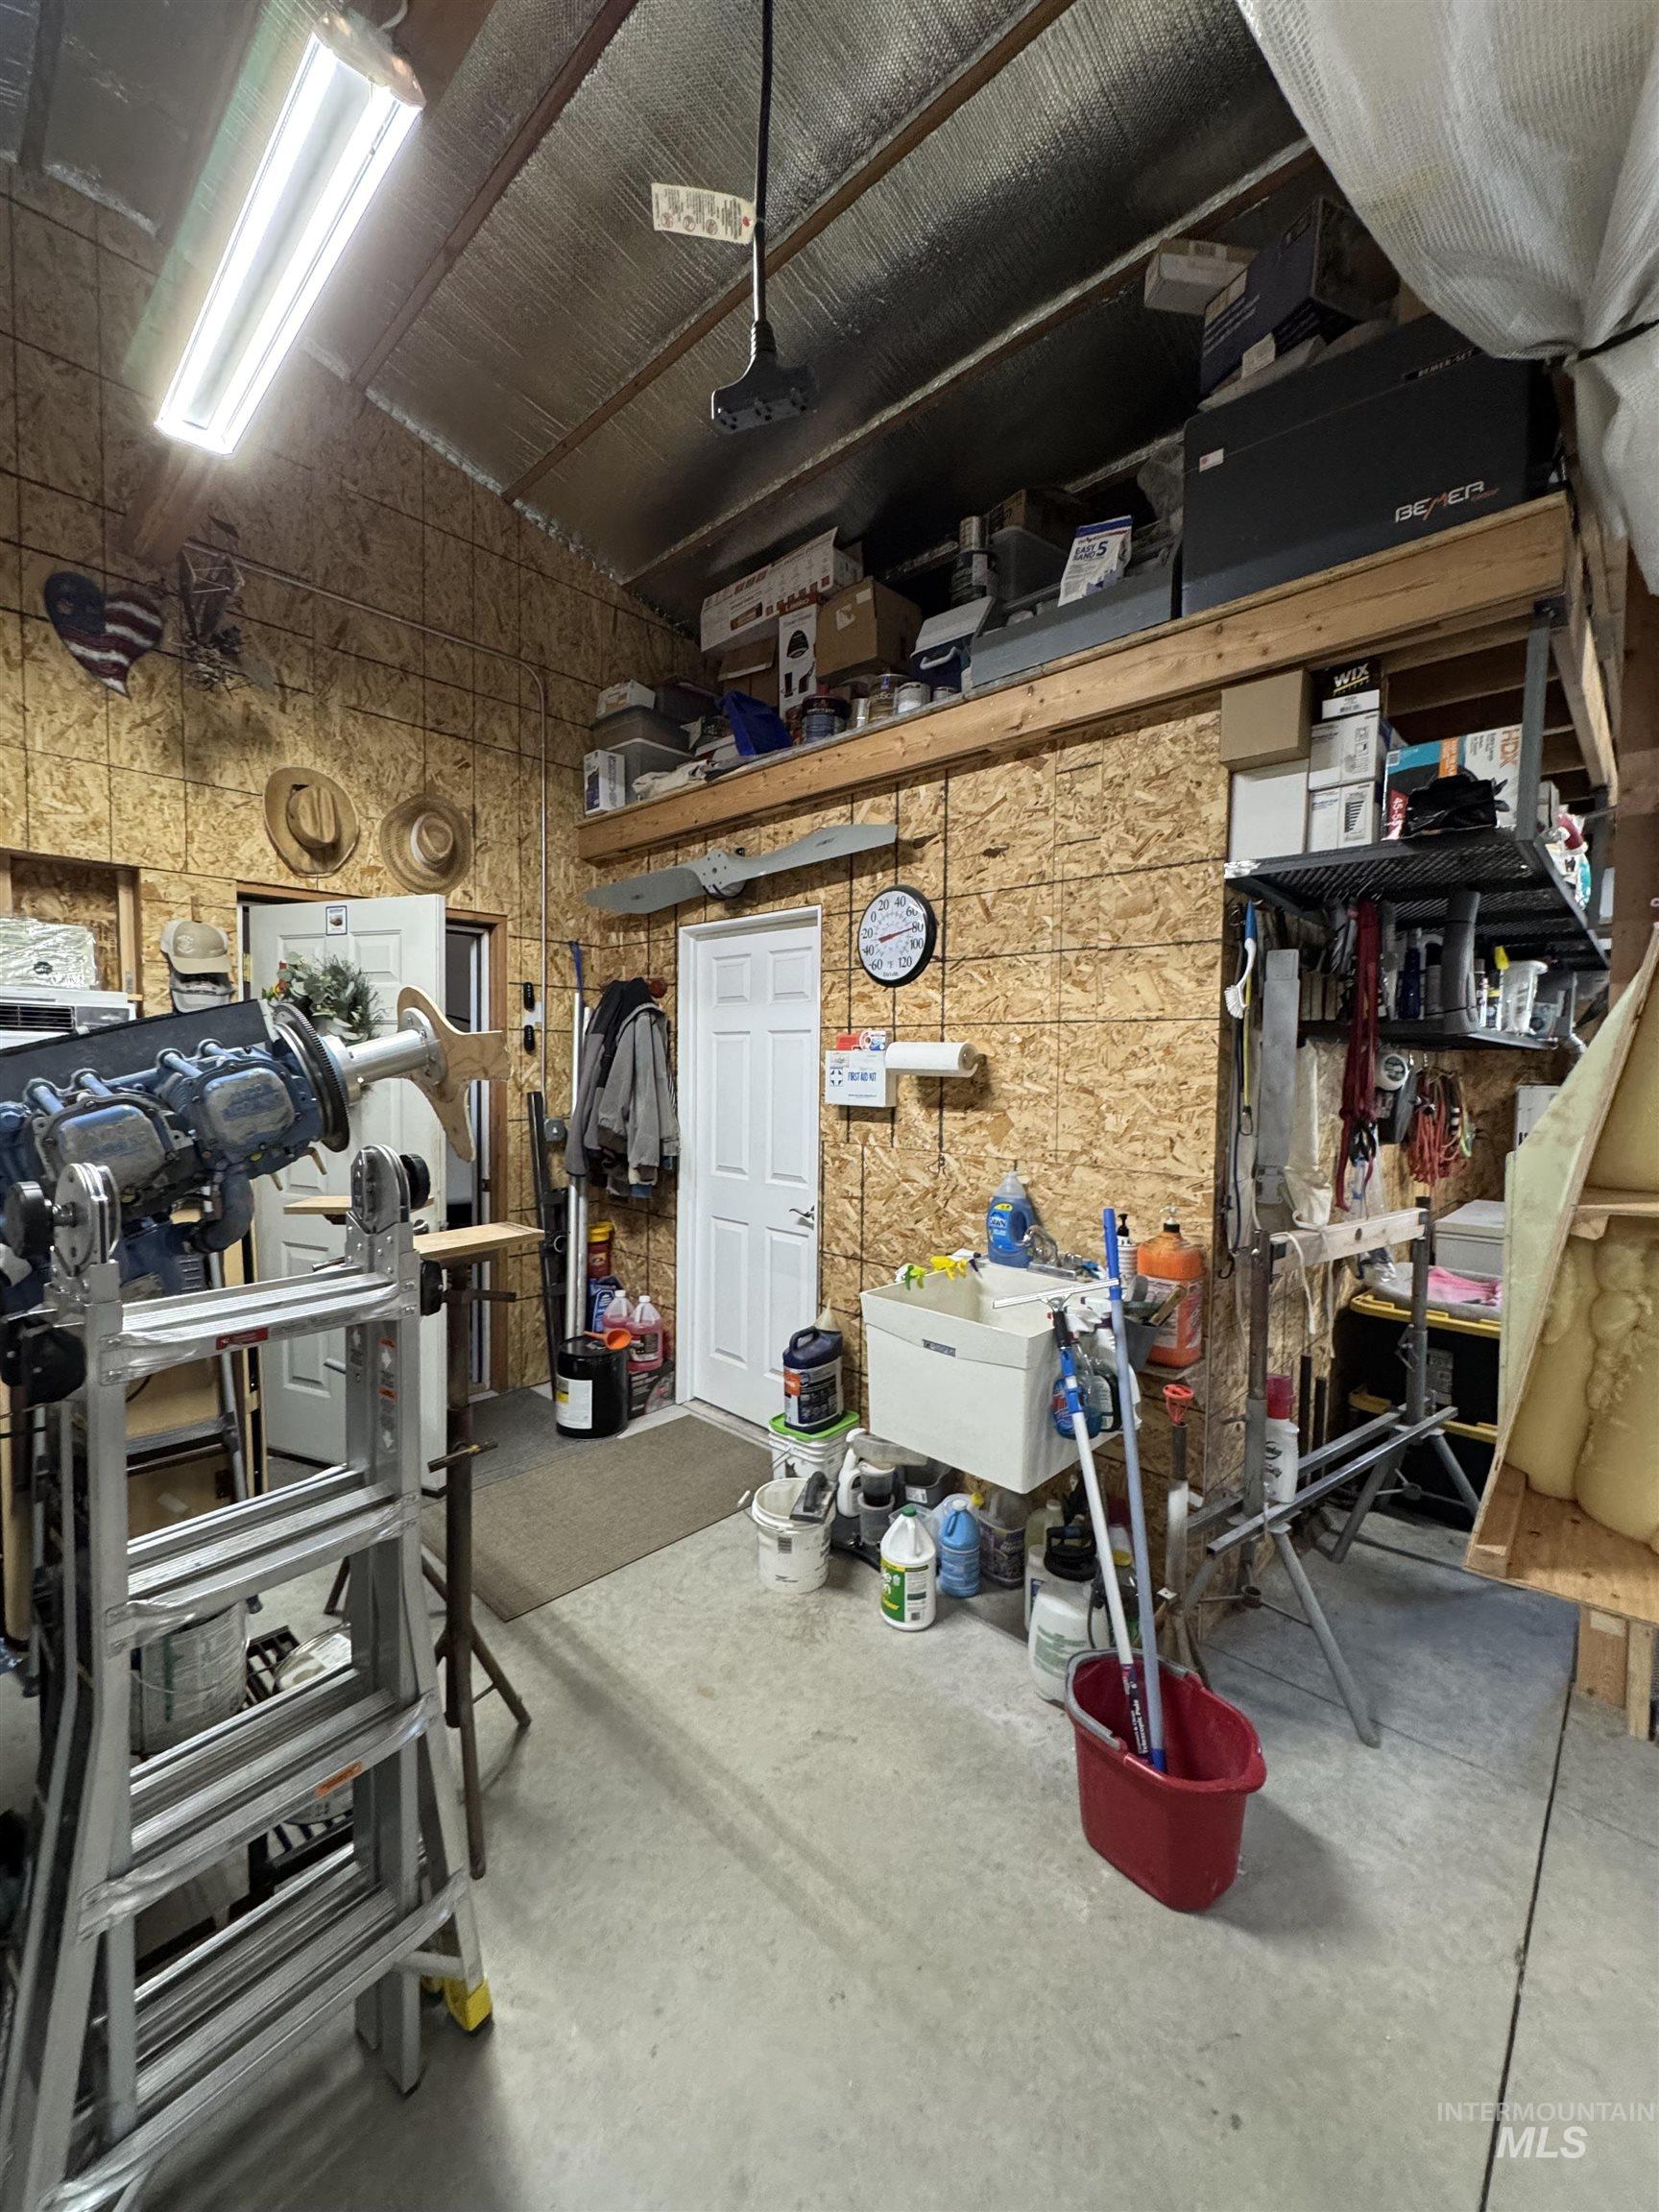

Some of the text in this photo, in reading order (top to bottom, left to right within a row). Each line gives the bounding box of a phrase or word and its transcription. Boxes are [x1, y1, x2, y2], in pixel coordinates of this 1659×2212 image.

[1395, 480, 1485, 524] BEMER
[1075, 541, 1109, 557] EASY 5
[1334, 662, 1370, 688] WIX
[1500, 728, 1521, 768] HDX
[878, 899, 890, 911] 20
[895, 895, 906, 908] 40
[870, 911, 877, 923] 0
[905, 905, 919, 917] 60
[911, 921, 924, 933] 80
[910, 937, 925, 950] 100
[898, 955, 913, 969] 120
[847, 1071, 860, 1082] FIRST
[860, 1071, 869, 1081] AID
